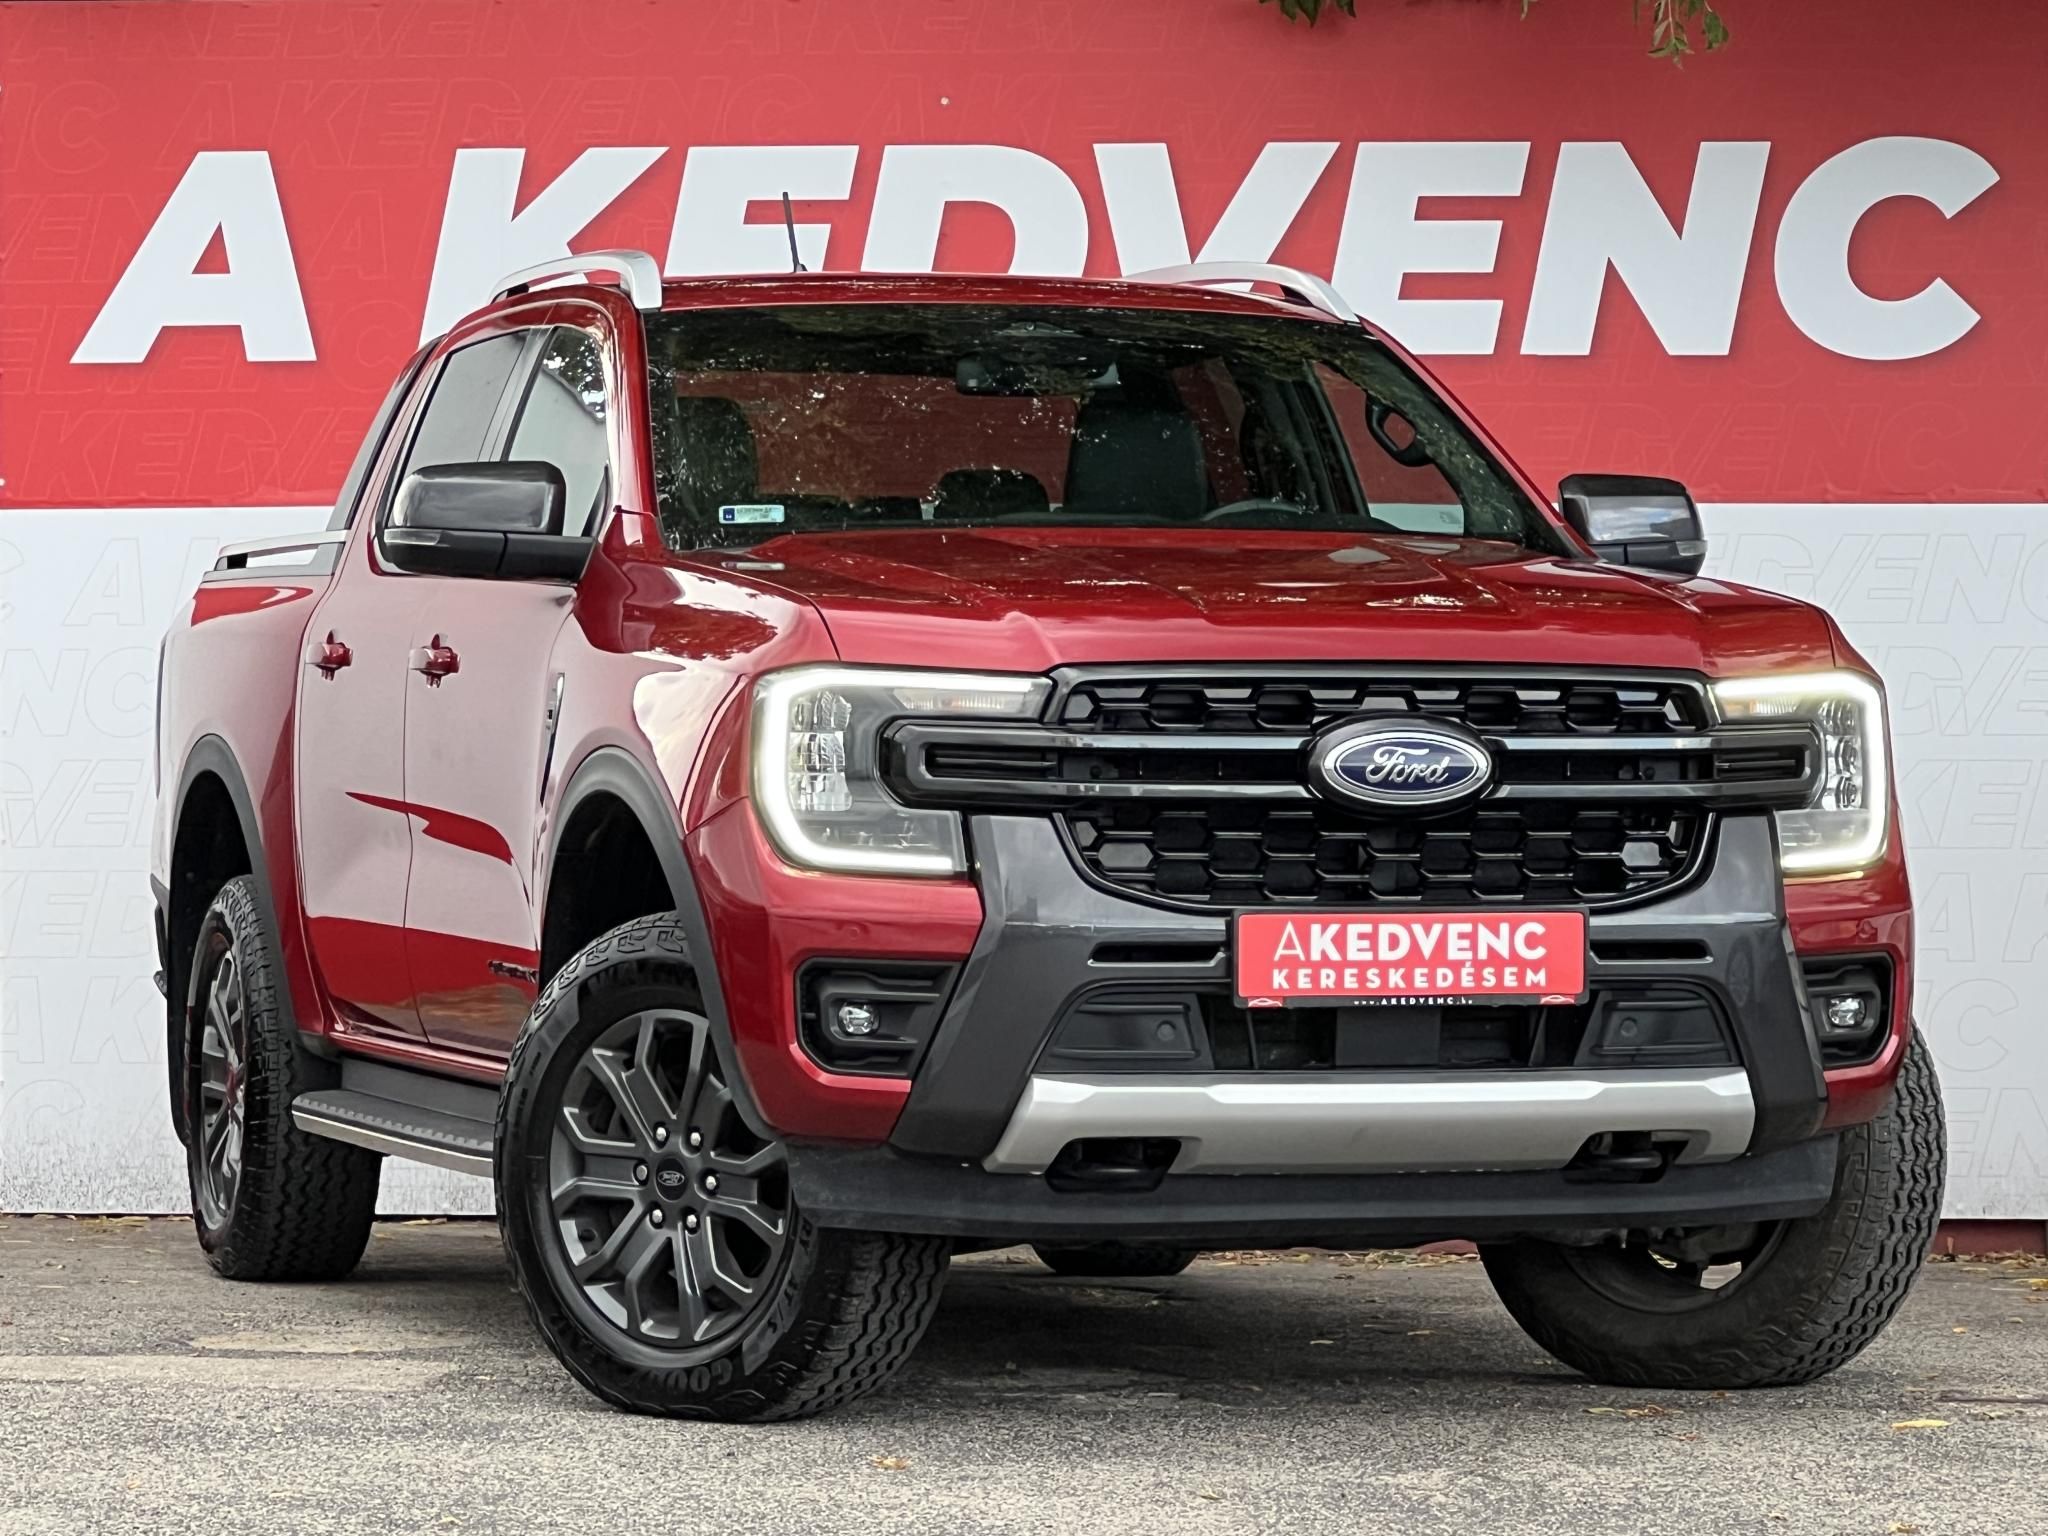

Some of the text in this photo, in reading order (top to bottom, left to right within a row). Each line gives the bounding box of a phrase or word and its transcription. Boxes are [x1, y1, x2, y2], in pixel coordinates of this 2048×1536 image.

[70, 150, 318, 364] A
[419, 136, 2001, 361] KEDVENC
[1365, 746, 1451, 784] Ford
[1272, 961, 1547, 990] KERESKEDÉSEM
